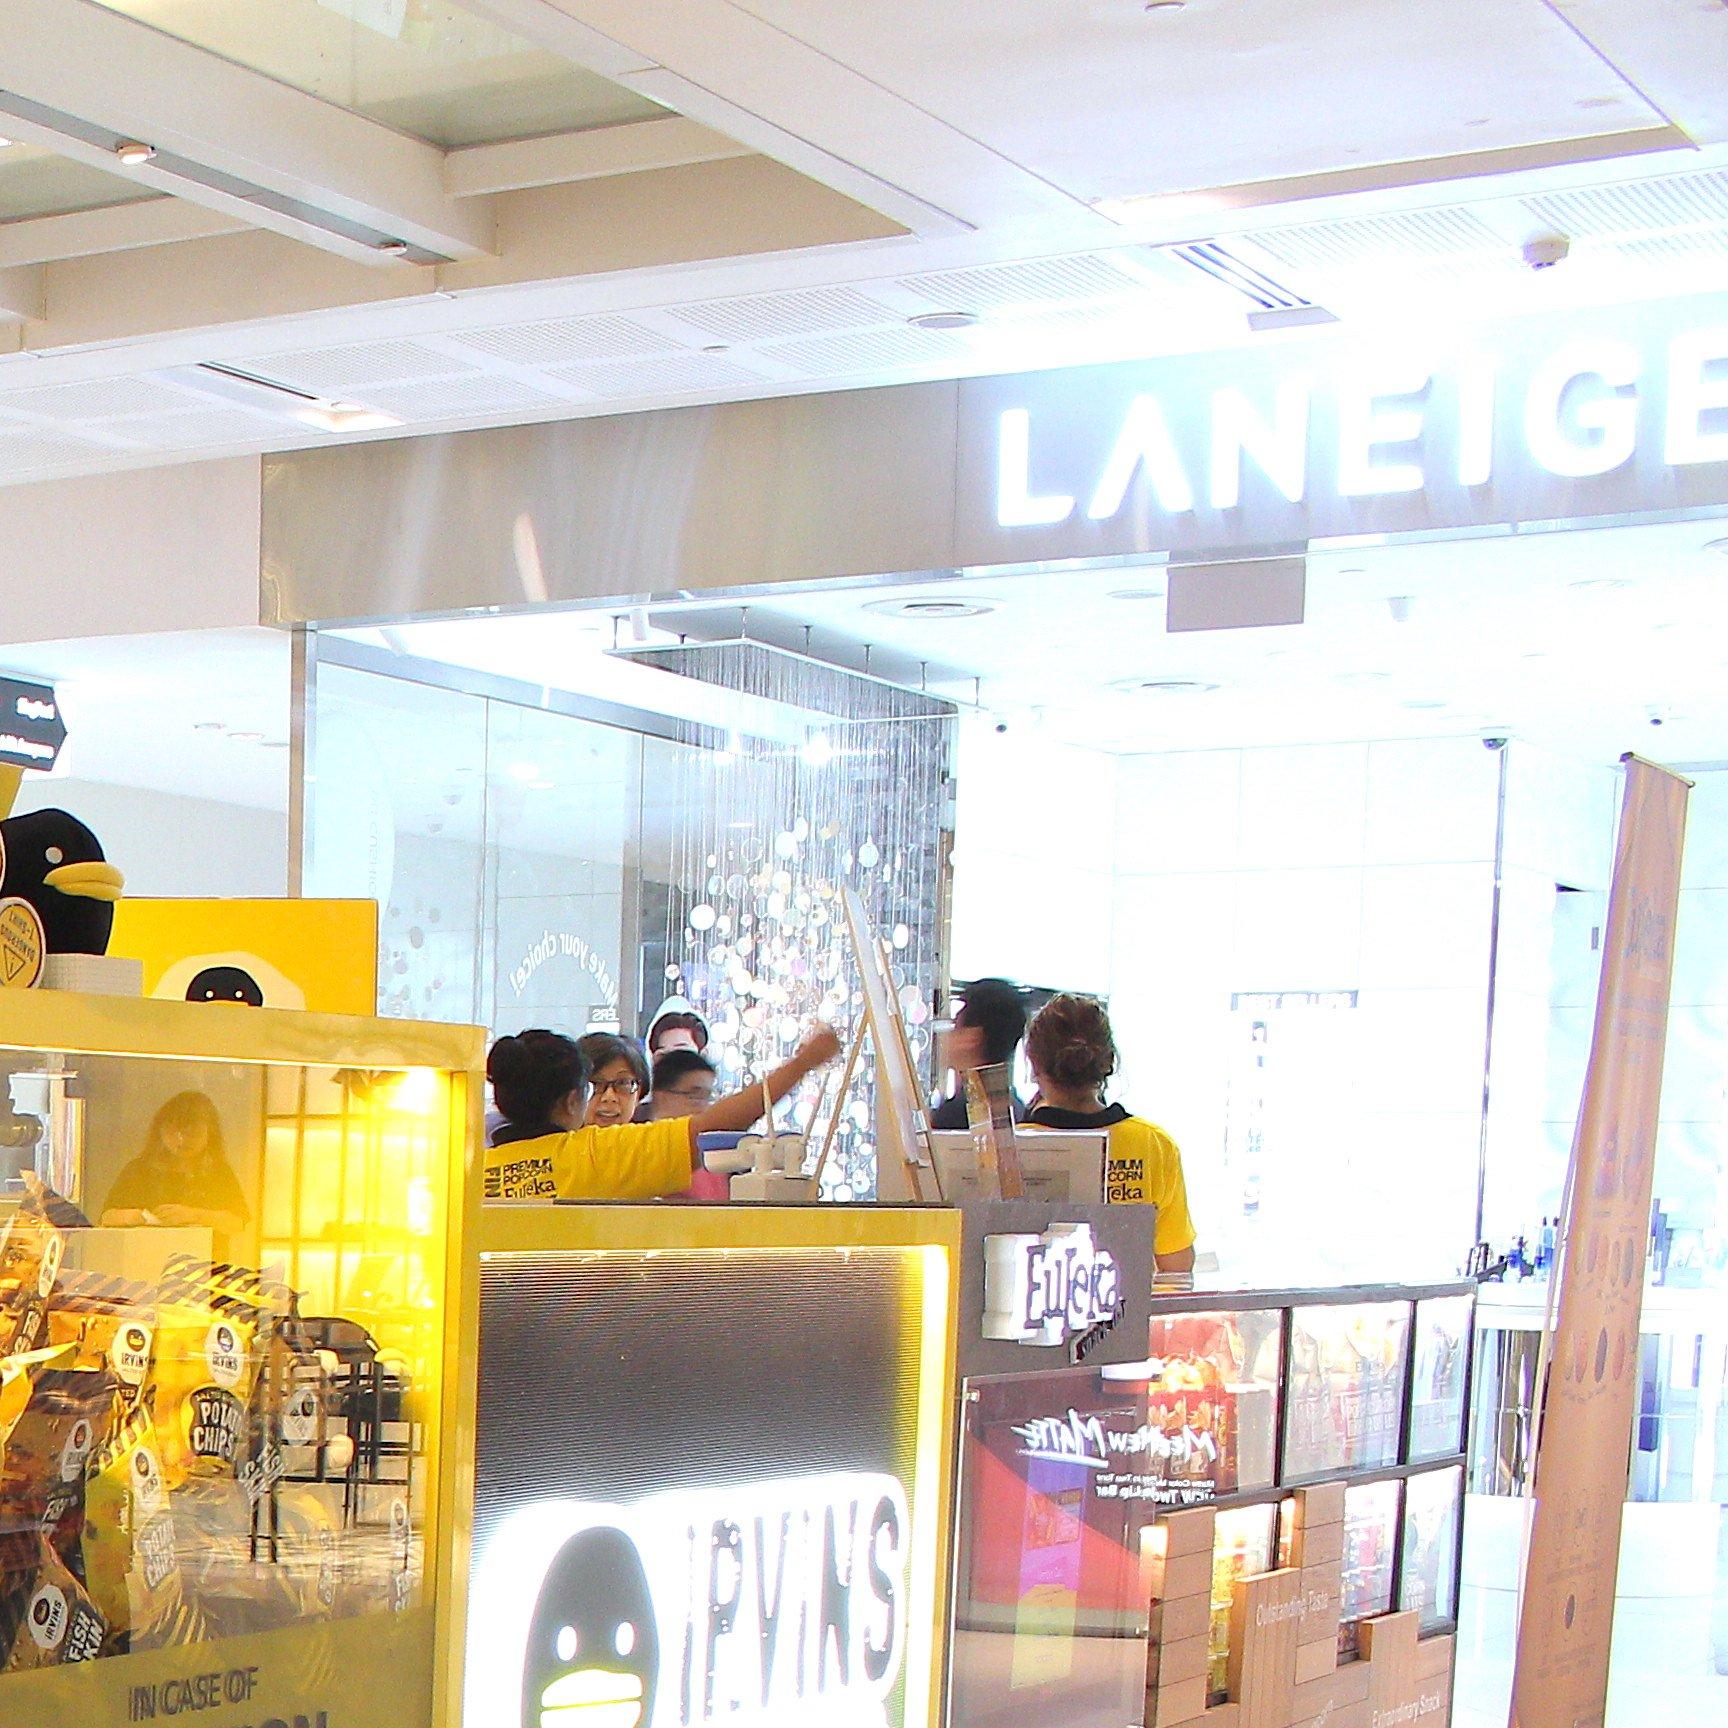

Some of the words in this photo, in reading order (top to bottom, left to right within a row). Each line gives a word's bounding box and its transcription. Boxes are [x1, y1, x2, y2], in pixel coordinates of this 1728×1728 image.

[996, 325, 1728, 528] LANEIGE
[193, 1426, 237, 1457] CHIPS
[44, 1599, 63, 1641] IRVINS
[128, 1684, 157, 1722] IN
[160, 1673, 223, 1716] CASE
[224, 1666, 260, 1703] OF
